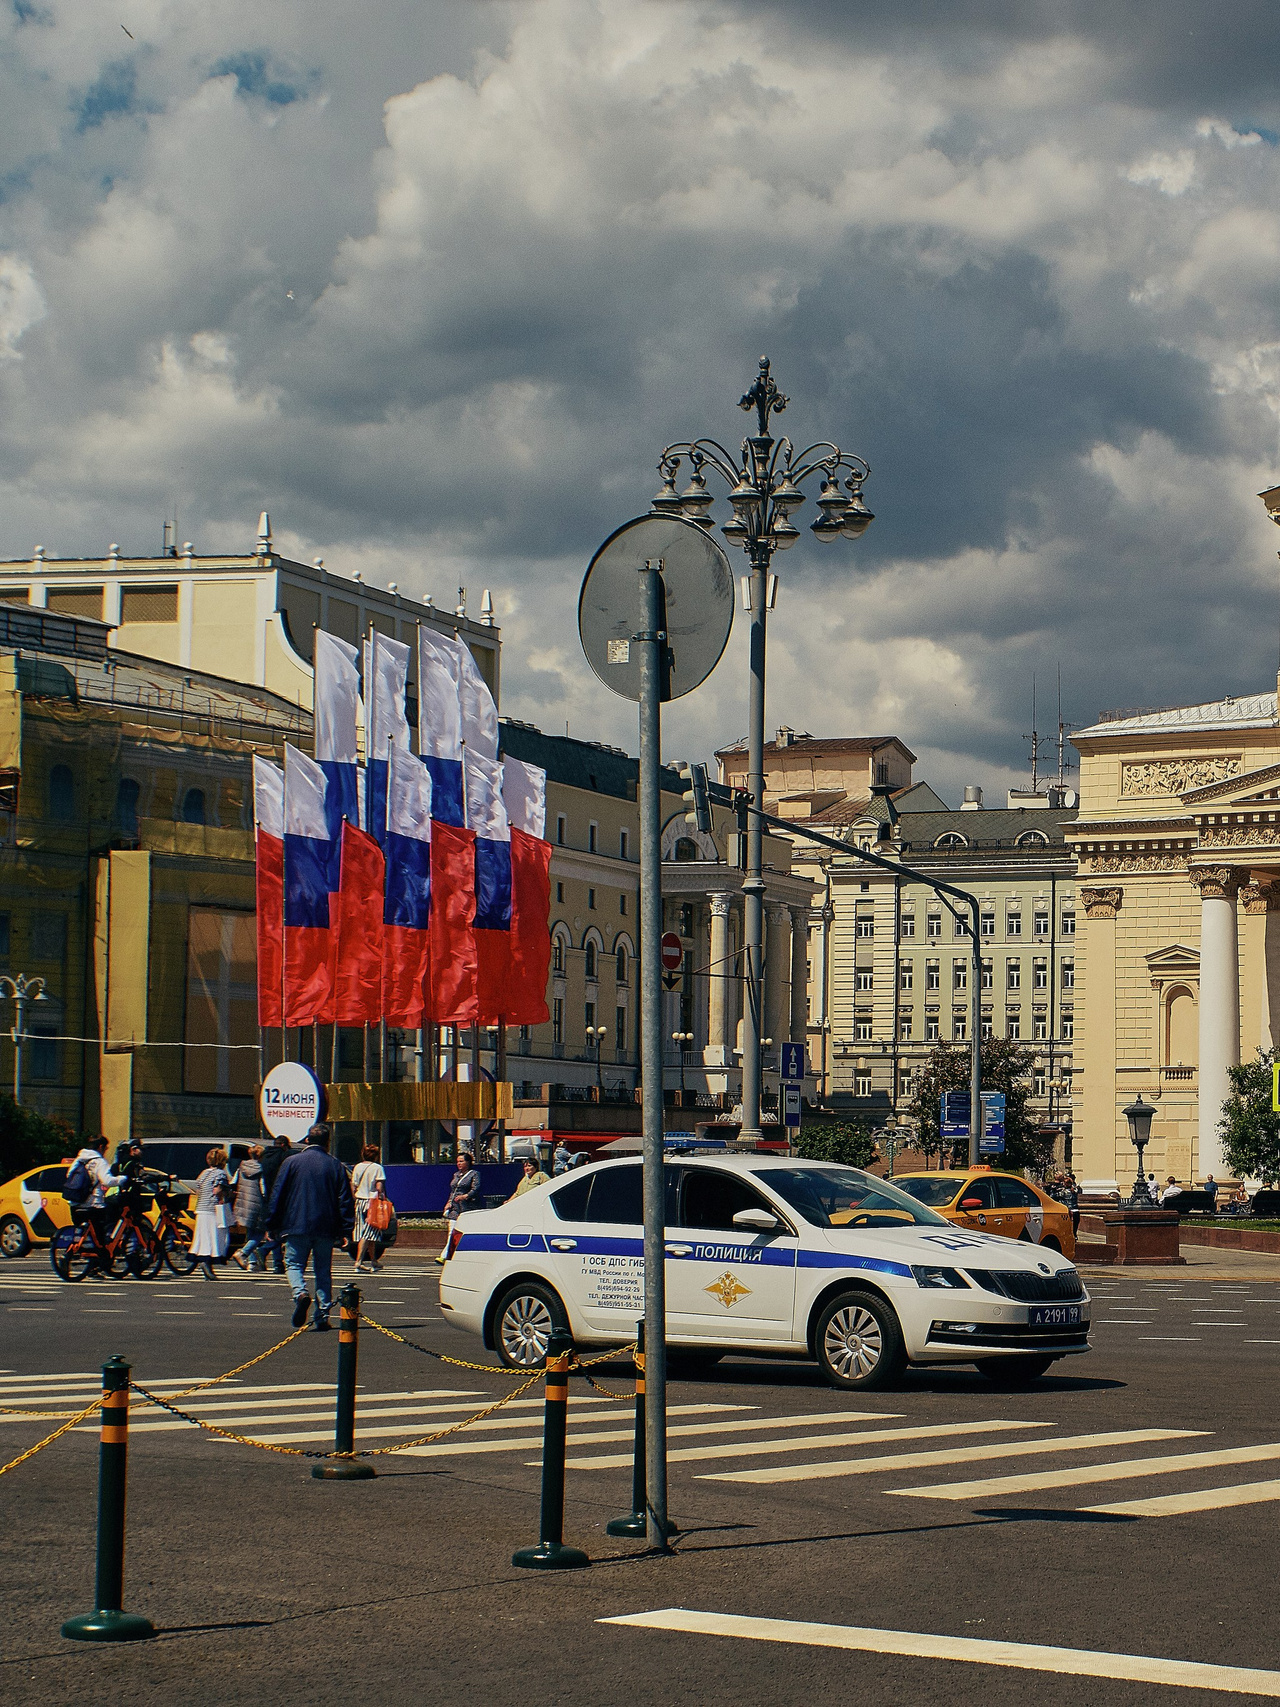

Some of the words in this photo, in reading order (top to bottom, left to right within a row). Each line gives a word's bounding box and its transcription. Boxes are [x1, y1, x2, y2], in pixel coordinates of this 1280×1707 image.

[265, 1088, 280, 1103] 12
[282, 1094, 315, 1104] ИЮНЯ
[267, 1110, 315, 1118] #МЫВМЕСТЕ
[695, 1245, 763, 1263] ПОЛИЦИЯ
[589, 1257, 606, 1265] ОСБ
[608, 1258, 626, 1267] ДПС
[628, 1259, 645, 1267] ГИБ
[1036, 1312, 1041, 1323] А
[1045, 1309, 1066, 1323] 2191
[1070, 1308, 1078, 1318] 99
